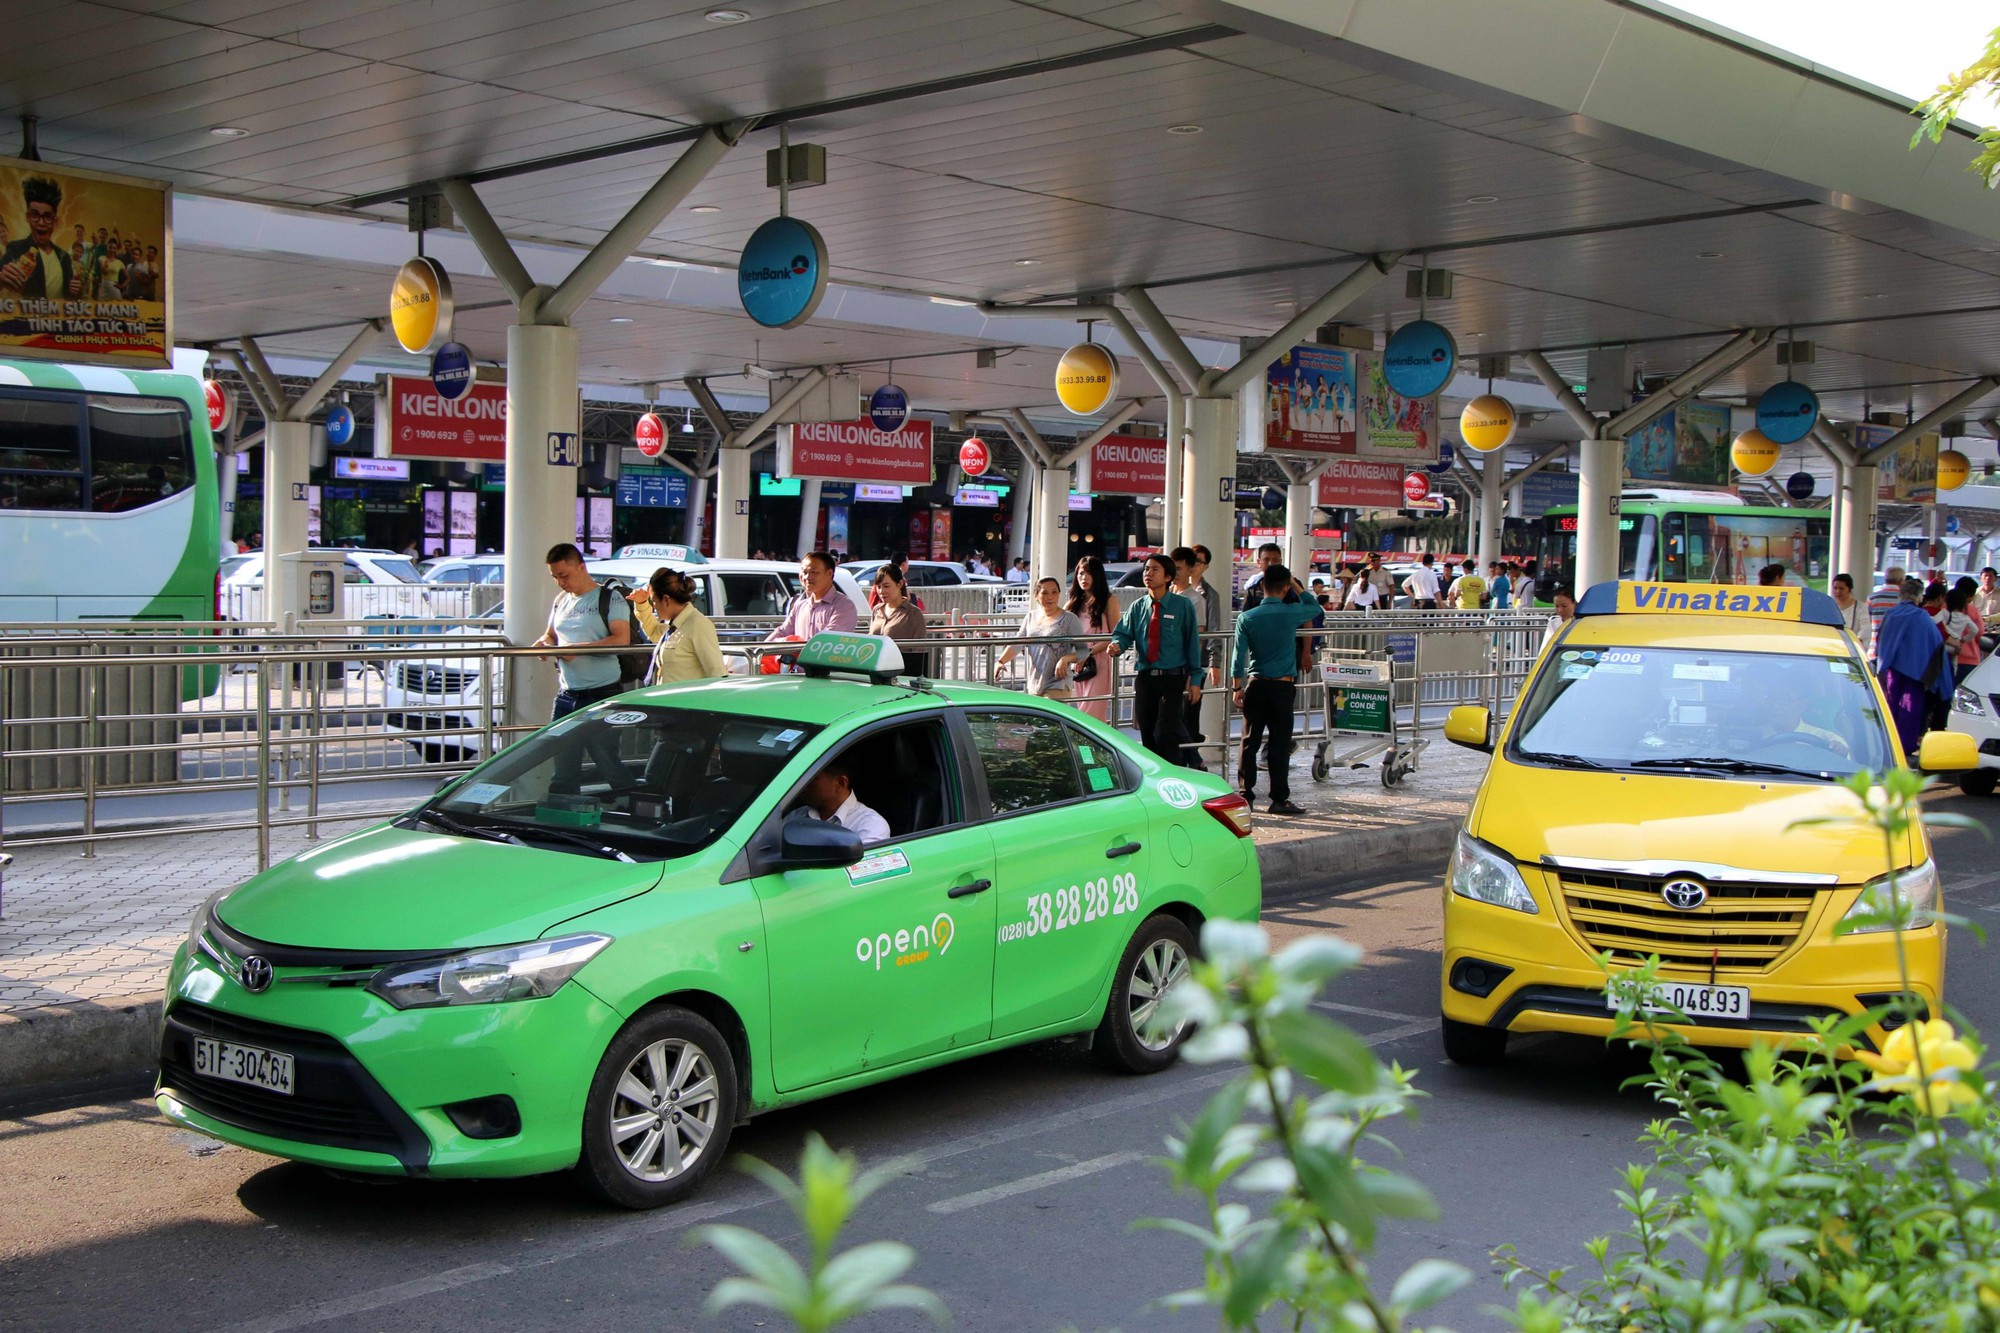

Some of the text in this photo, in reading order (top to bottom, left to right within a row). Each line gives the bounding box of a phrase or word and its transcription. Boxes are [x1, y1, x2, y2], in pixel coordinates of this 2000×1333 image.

[20, 298, 60, 315] THÊM
[65, 300, 94, 316] SỨC
[97, 304, 139, 318] MẠNH
[55, 334, 84, 344] CHINH
[86, 337, 109, 346] PHỤC
[1059, 375, 1107, 385] 0933.33.99.88
[327, 421, 341, 432] VIB
[416, 429, 458, 441] 1900 6929
[800, 423, 925, 450] KIENLONGBANK
[810, 451, 841, 462] 1900 6929
[856, 456, 925, 469] www.kienlongbank.com
[961, 458, 984, 467] VIFON
[360, 463, 398, 473] VIETBANK
[637, 547, 684, 557] VINASUN TAXI
[1633, 586, 1788, 613] Vinataxi
[1600, 652, 1642, 663] 5008
[1361, 693, 1388, 701] NHANH
[613, 712, 638, 722] 1213
[1162, 783, 1191, 803] 1213
[1026, 892, 1053, 937] 38
[1055, 885, 1082, 930] 28
[1084, 877, 1109, 923] 28
[1113, 872, 1139, 915] 28
[896, 950, 929, 968] GROUP
[197, 1041, 289, 1090] 51F-304.64
